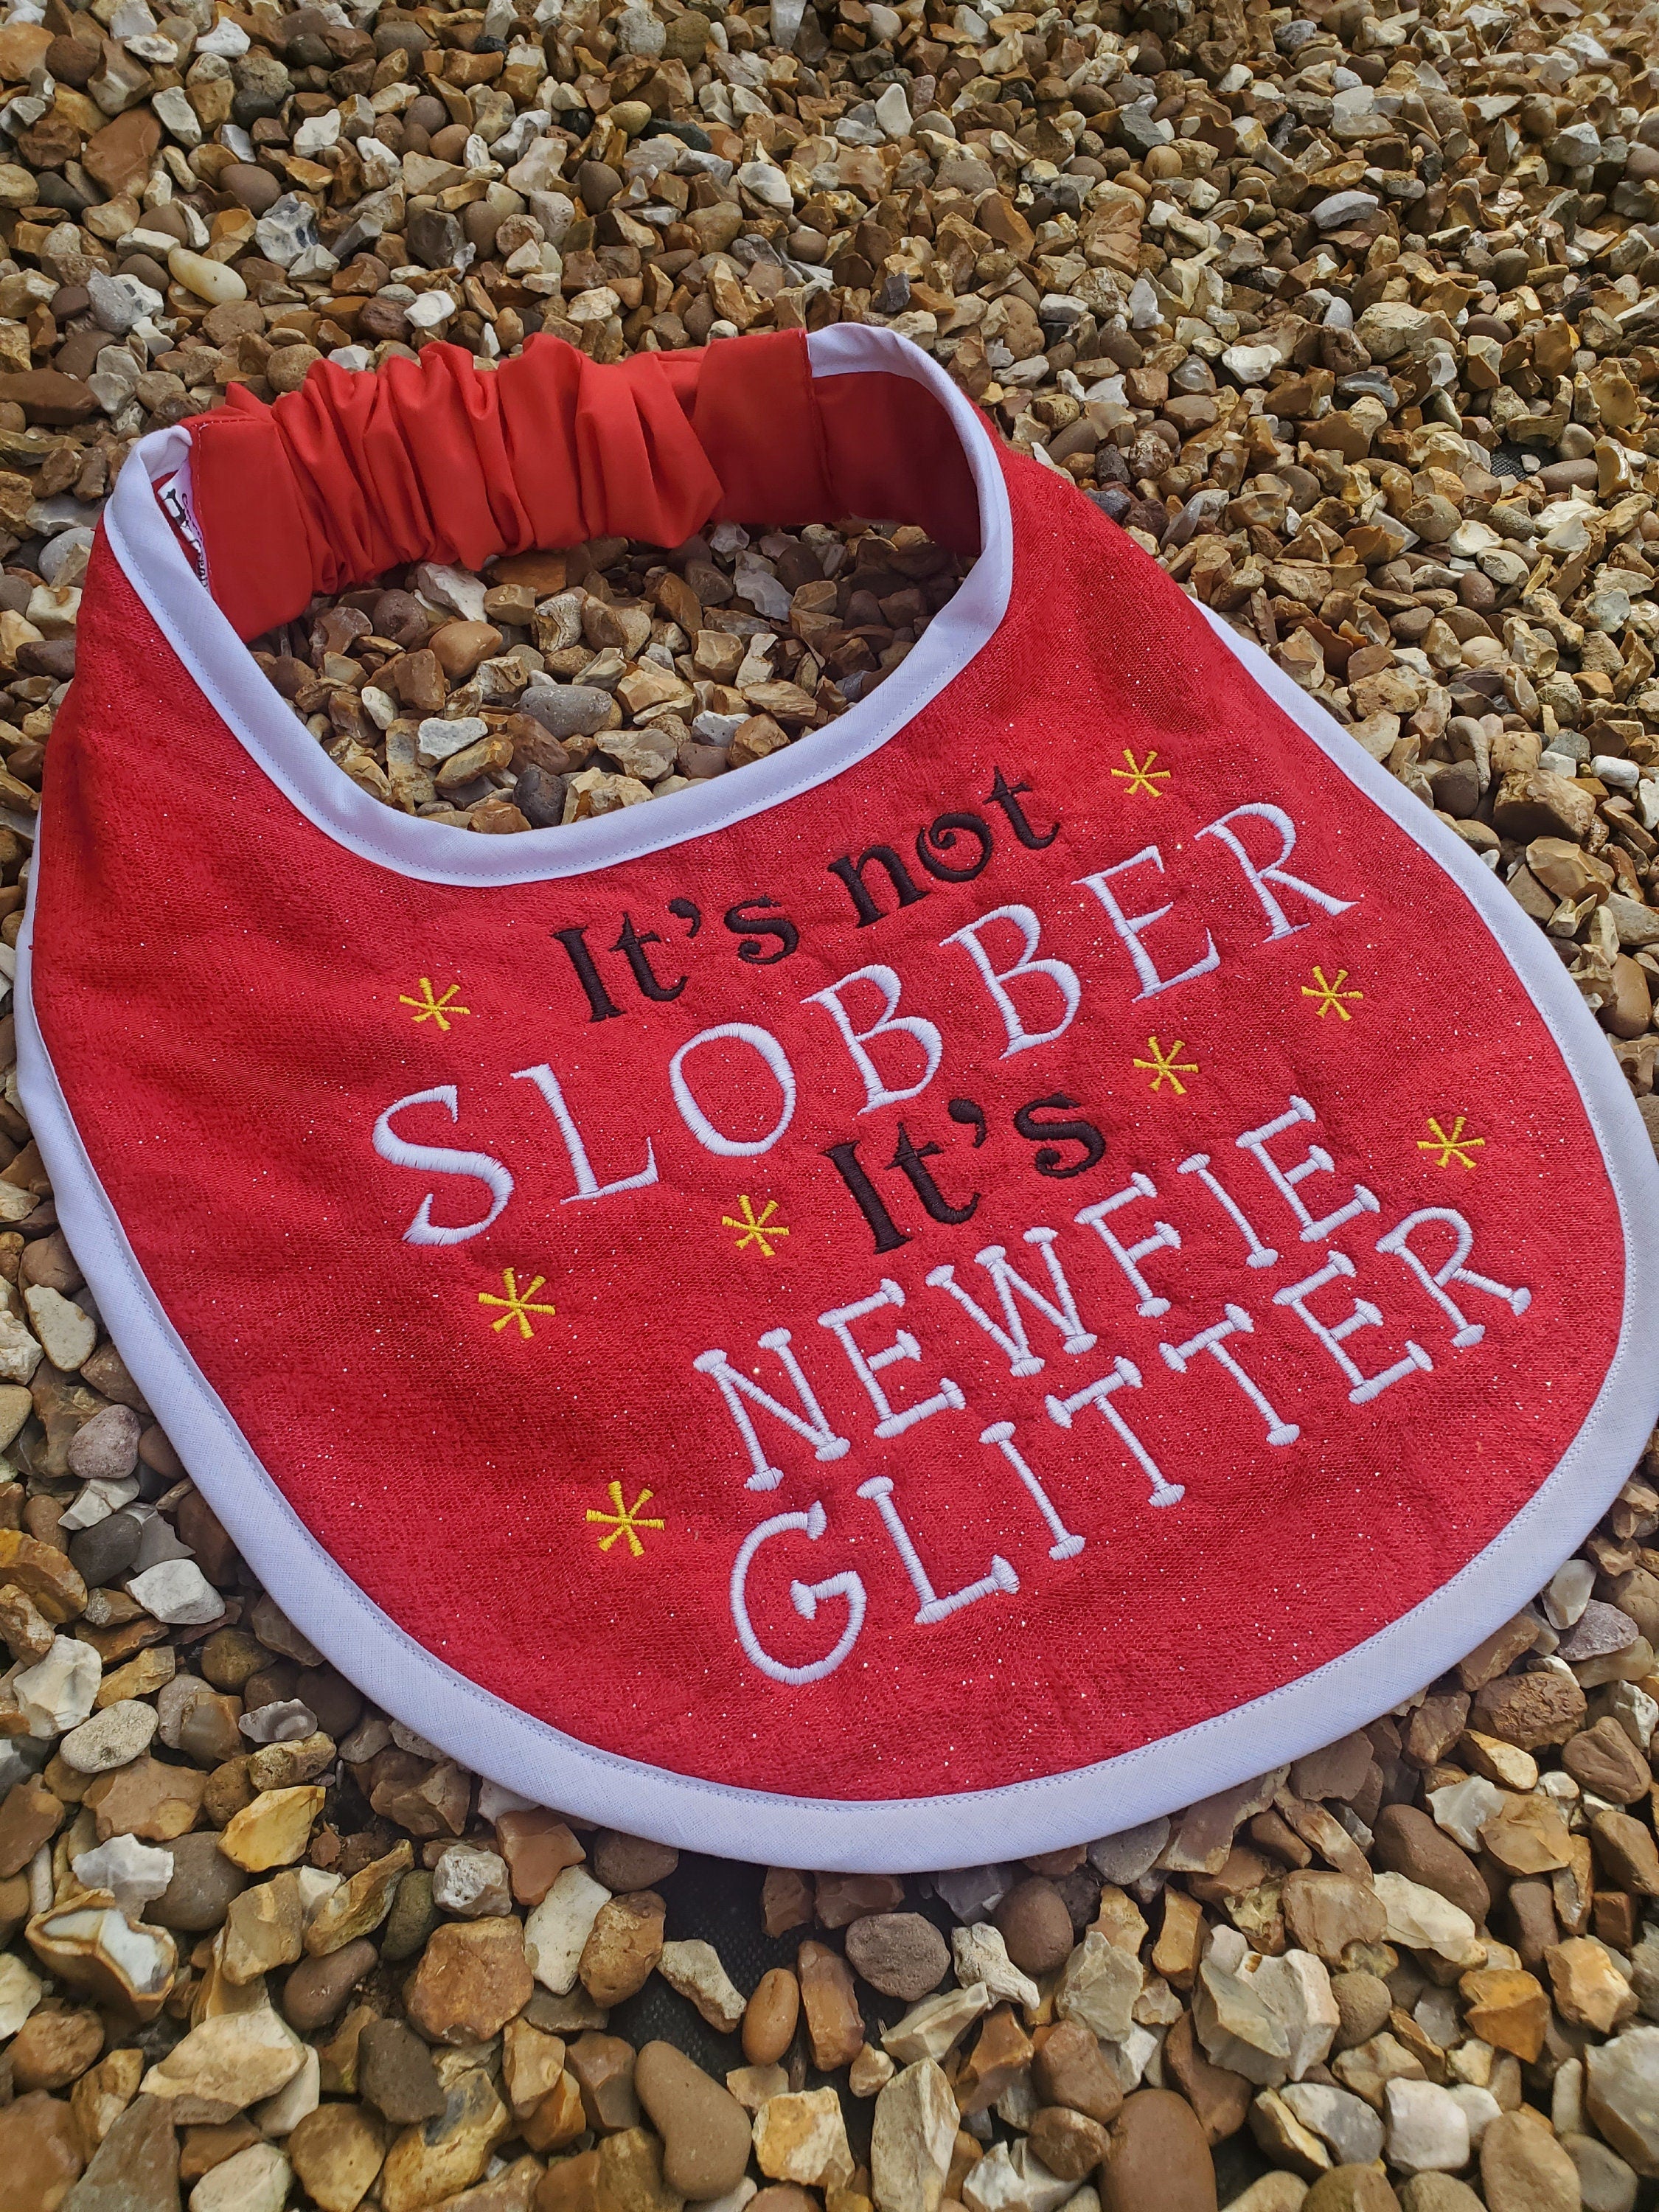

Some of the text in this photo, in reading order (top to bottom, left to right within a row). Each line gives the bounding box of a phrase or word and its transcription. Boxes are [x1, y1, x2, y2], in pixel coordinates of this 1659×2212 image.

[372, 801, 1358, 1246] SLOBBER
[552, 766, 1060, 1023] It's not
[693, 1095, 1380, 1492] NEWFIE
[823, 1091, 1107, 1255] It's
[731, 1206, 1531, 1688] GLITTER
